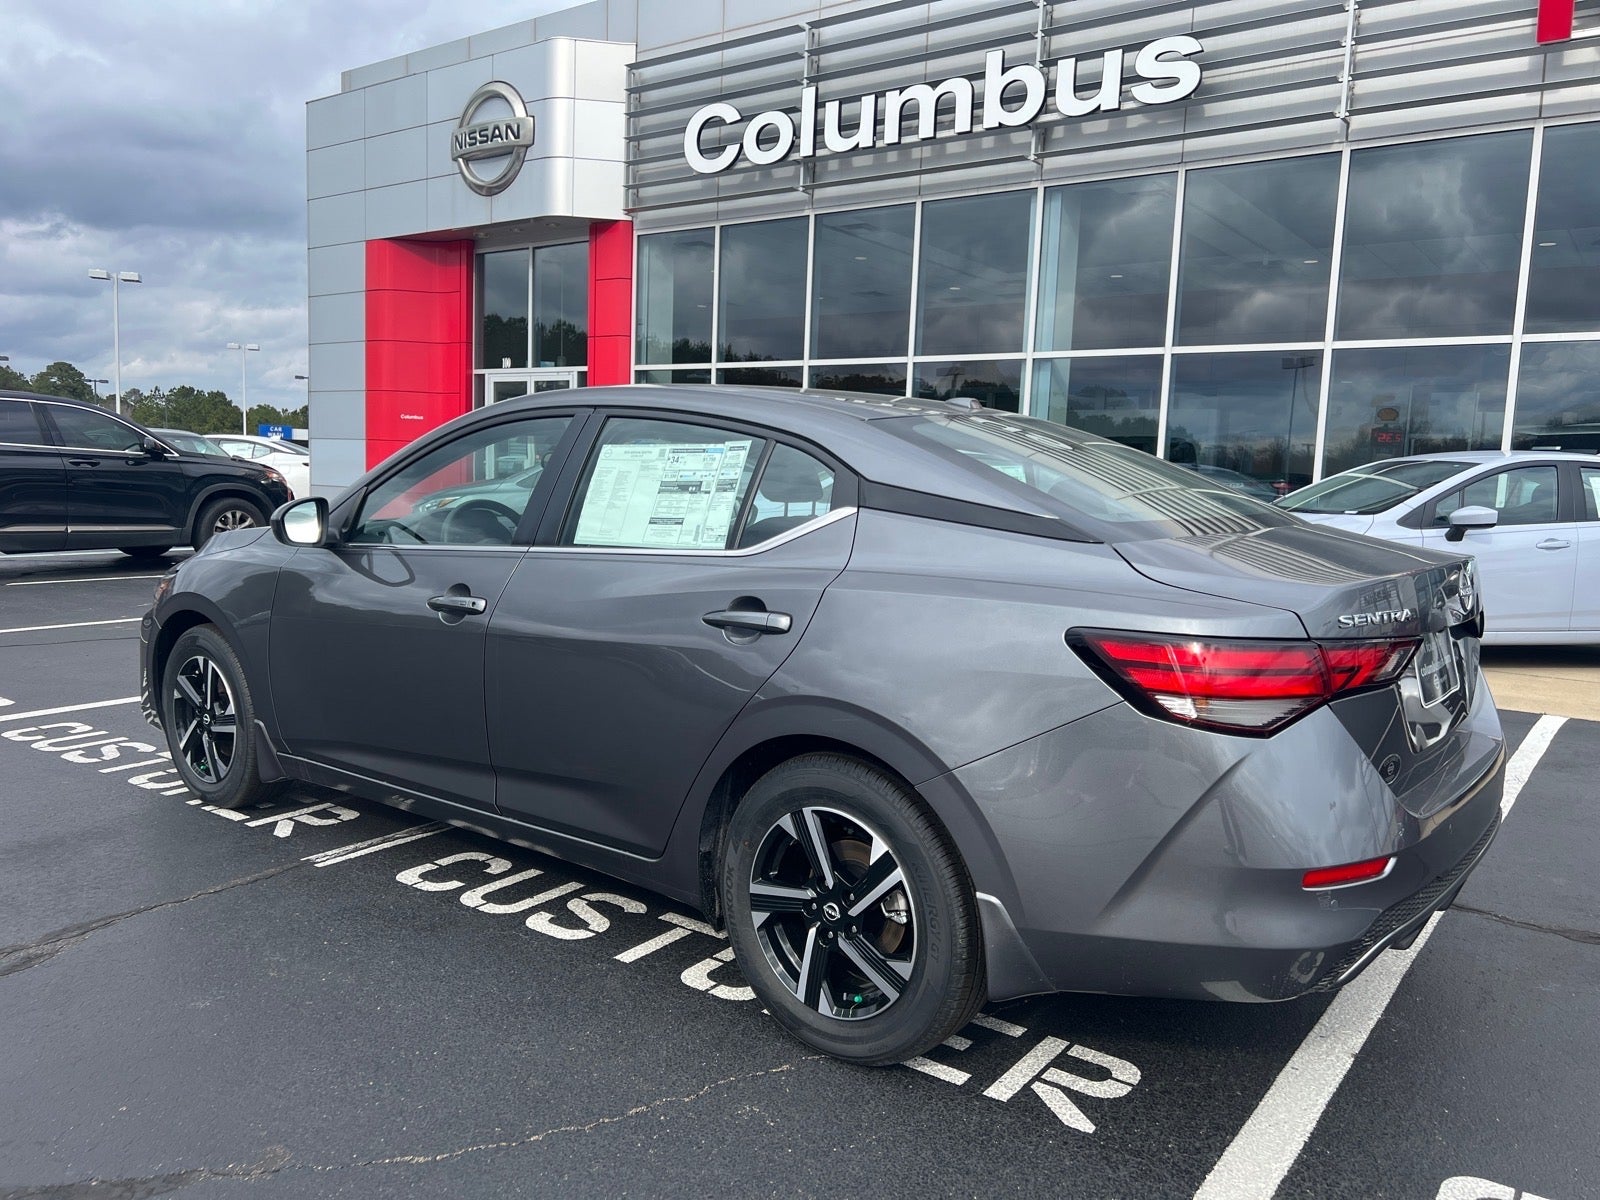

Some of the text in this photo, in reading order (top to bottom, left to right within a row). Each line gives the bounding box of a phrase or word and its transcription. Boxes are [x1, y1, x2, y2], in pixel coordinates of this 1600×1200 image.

[684, 35, 1204, 174] Columbus
[454, 123, 521, 152] NISSAN
[1338, 608, 1412, 630] SENTRA
